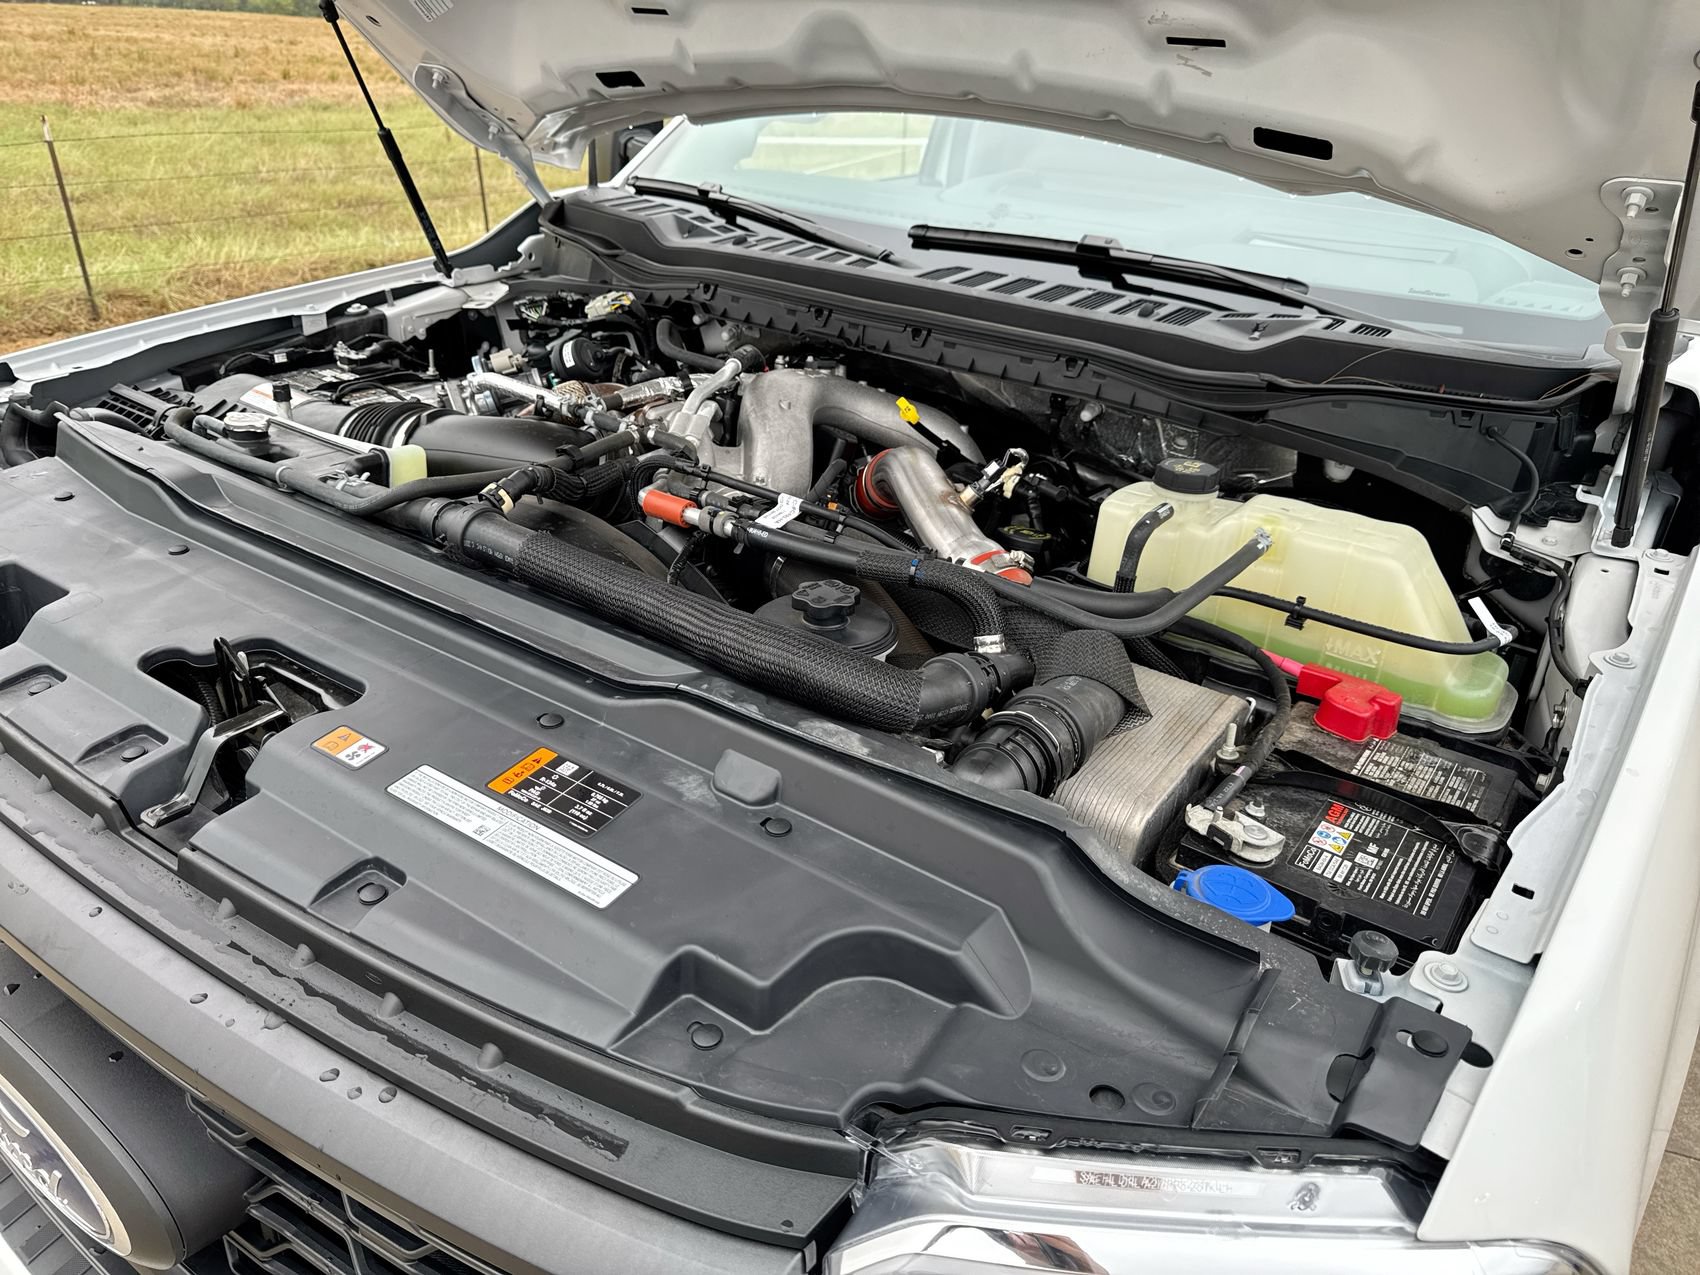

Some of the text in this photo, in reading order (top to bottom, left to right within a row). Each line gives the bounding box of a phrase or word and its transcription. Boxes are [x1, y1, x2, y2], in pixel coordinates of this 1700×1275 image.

[508, 790, 529, 803] FoMoCo
[498, 806, 541, 831] MODIFICATION
[1325, 803, 1345, 824] AGM
[1299, 847, 1316, 869] FoMoCo
